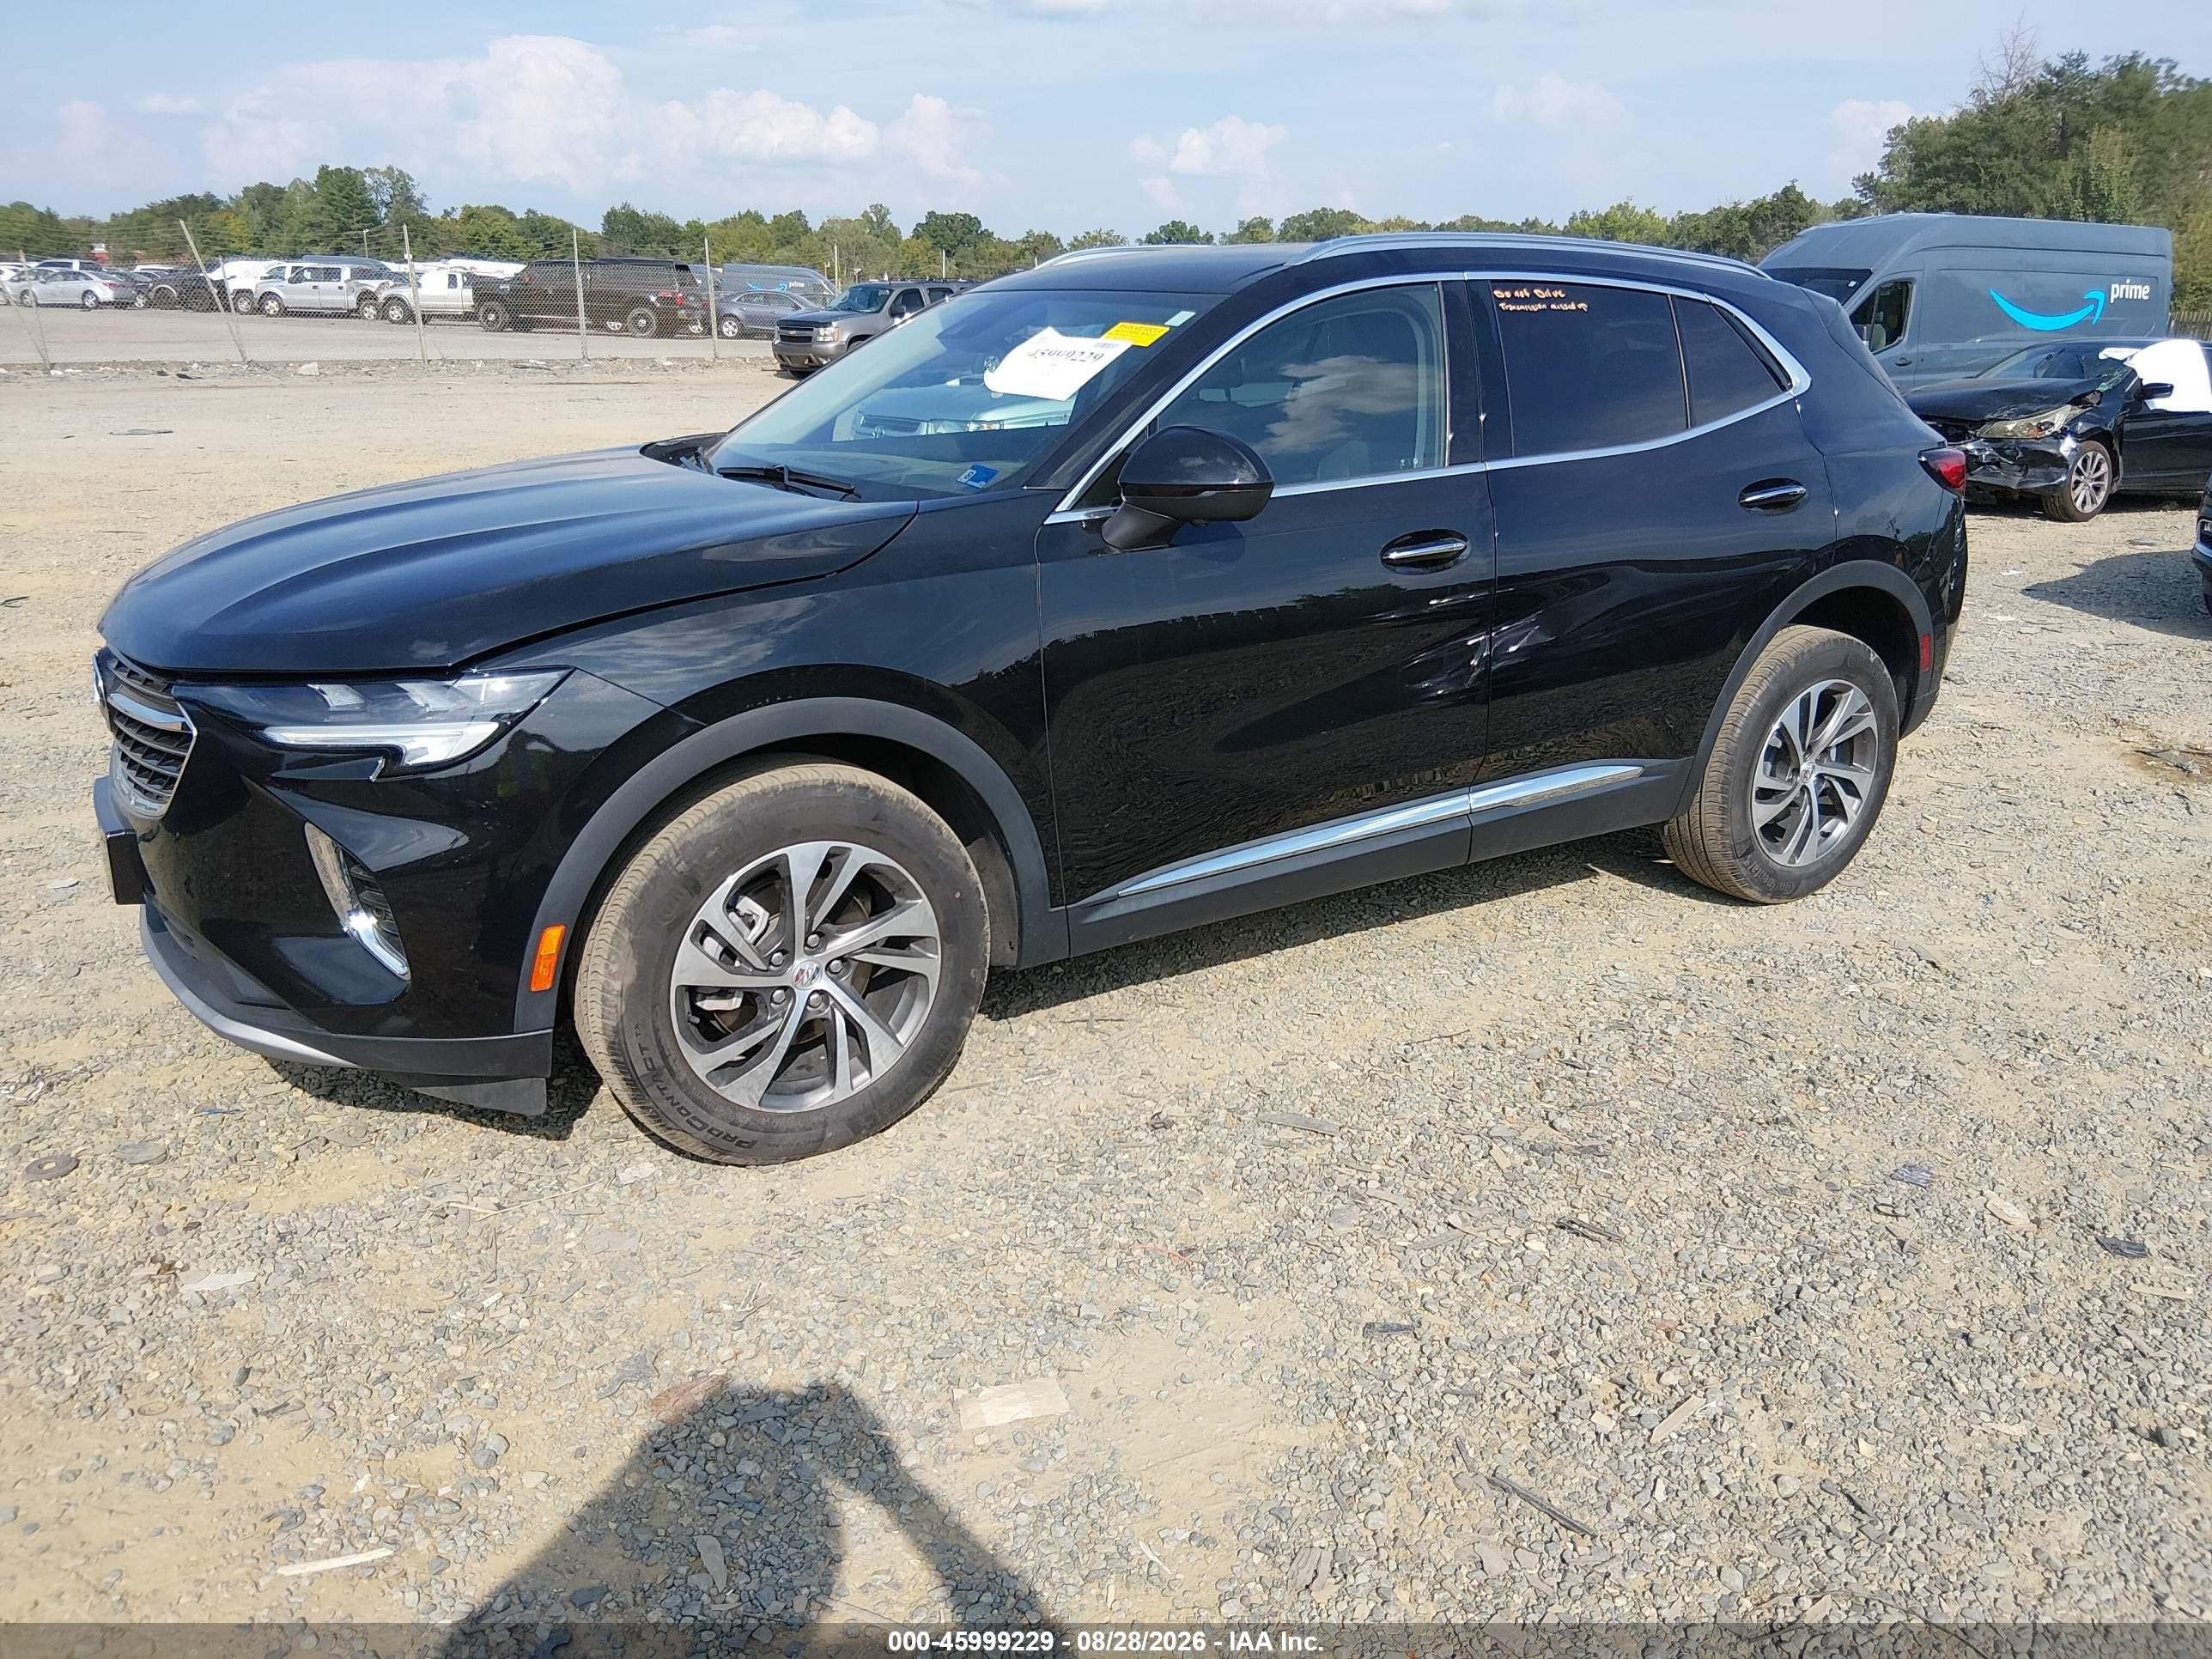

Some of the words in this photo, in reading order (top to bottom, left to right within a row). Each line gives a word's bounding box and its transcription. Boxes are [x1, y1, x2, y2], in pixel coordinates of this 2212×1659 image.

[1493, 289, 1511, 298] Do
[1514, 289, 1530, 298] not
[1533, 289, 1565, 298] Drive
[2110, 279, 2150, 303] prime
